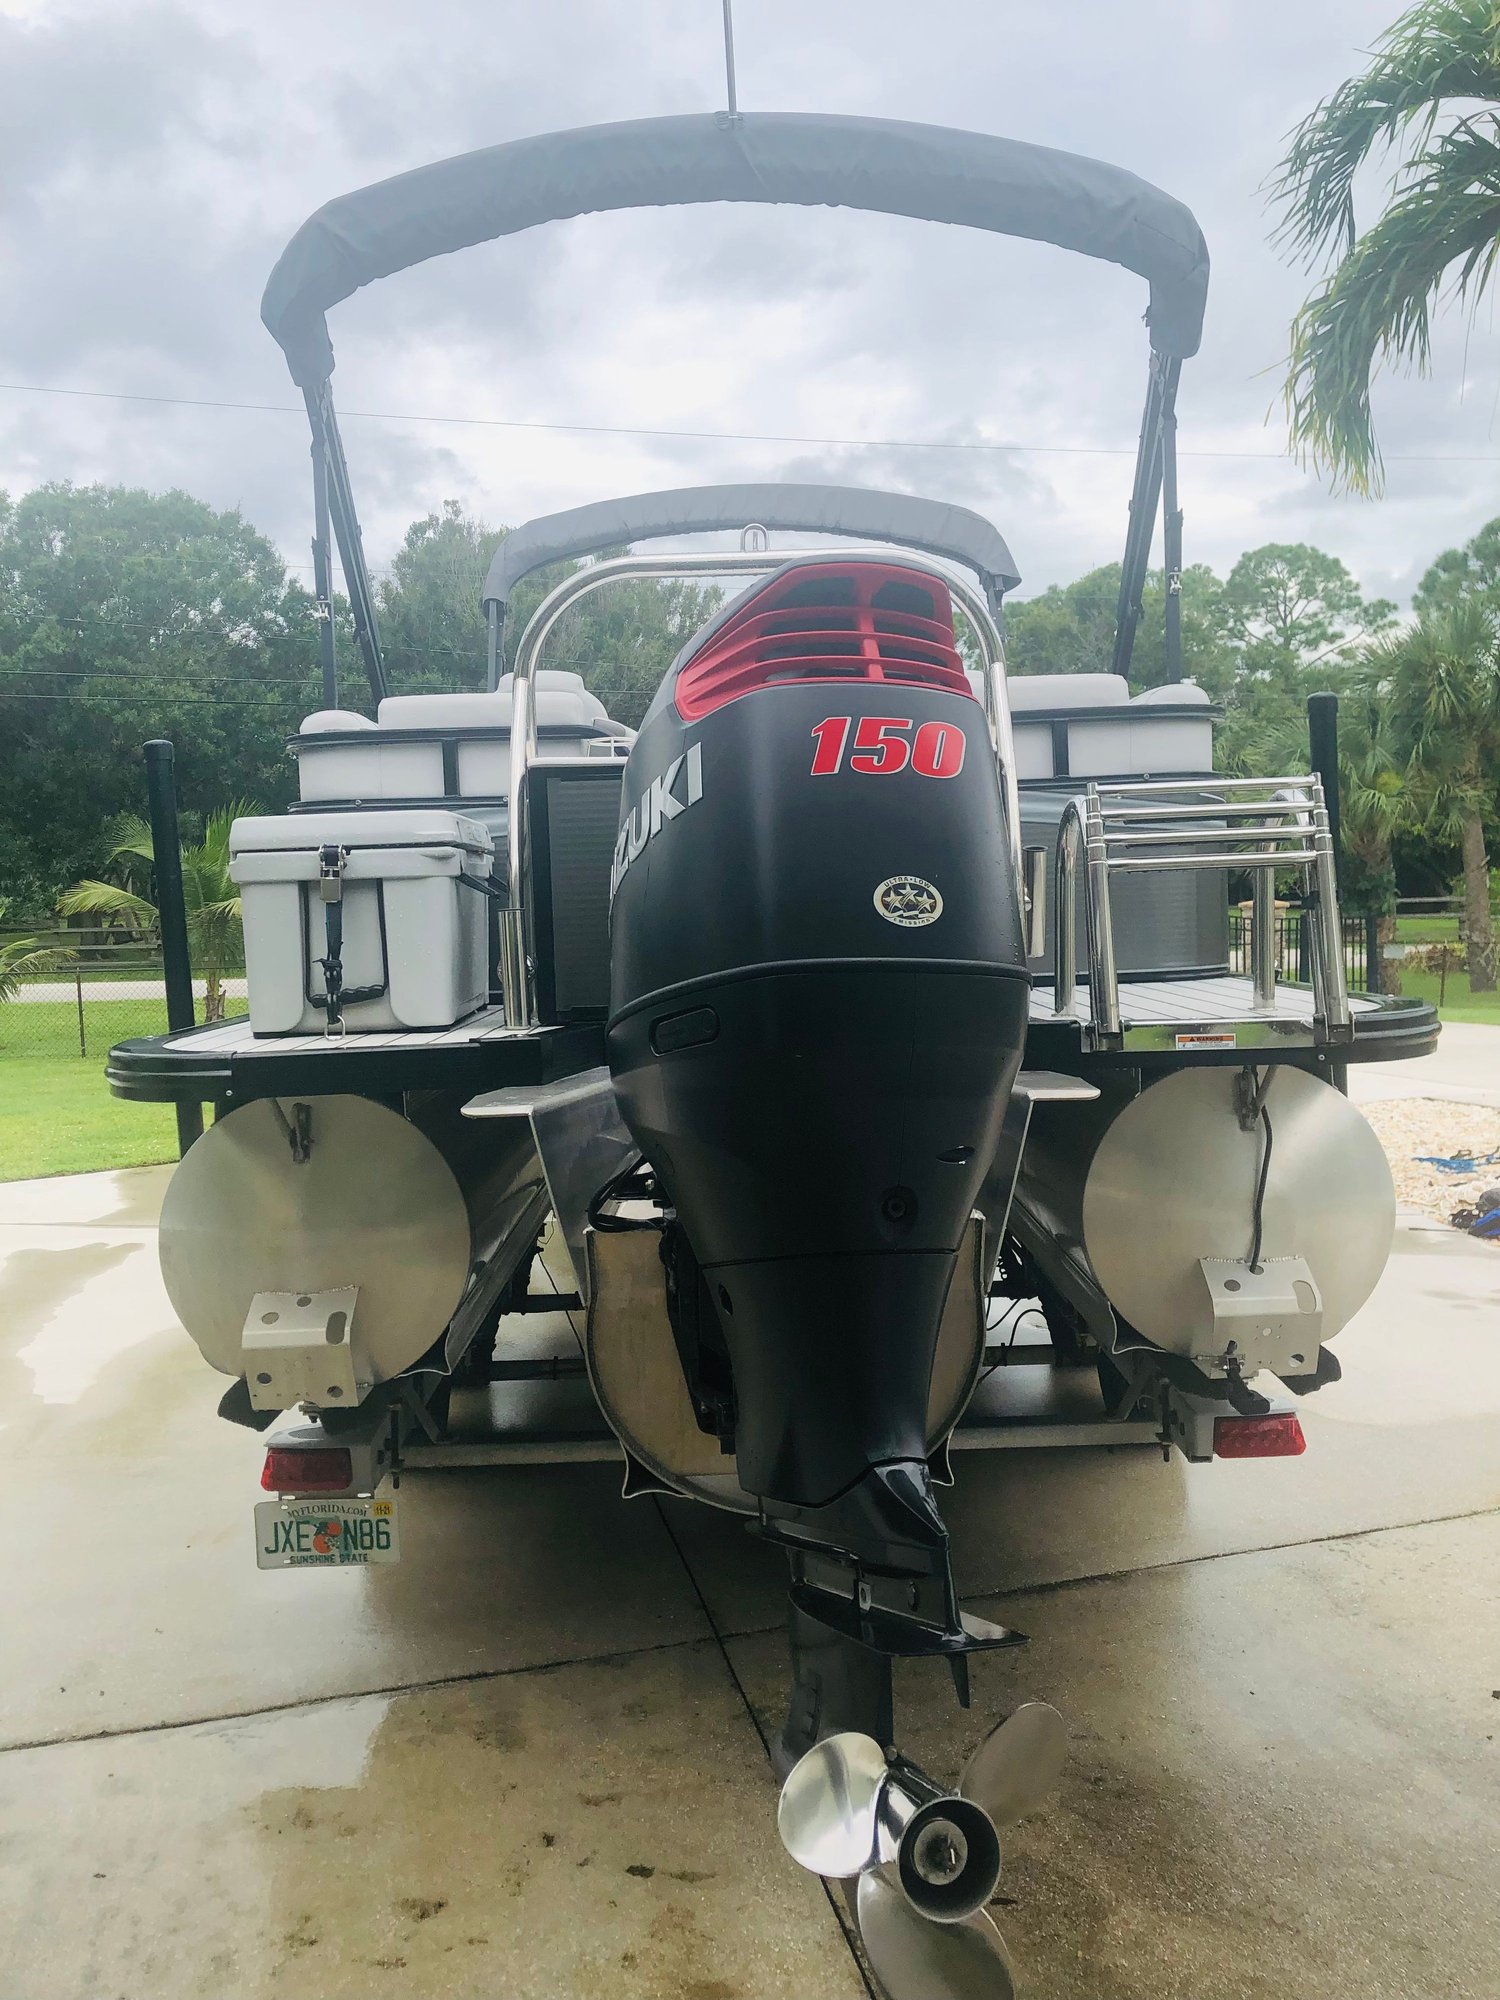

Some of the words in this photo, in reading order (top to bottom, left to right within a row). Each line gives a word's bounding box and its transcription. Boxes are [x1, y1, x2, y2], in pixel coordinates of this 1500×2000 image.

[810, 716, 966, 778] 150
[608, 741, 704, 938] ZUKI
[264, 1519, 312, 1554] JXE
[342, 1518, 391, 1551] N86
[289, 1554, 335, 1565] SUNSHINE
[339, 1553, 368, 1563] STATE
